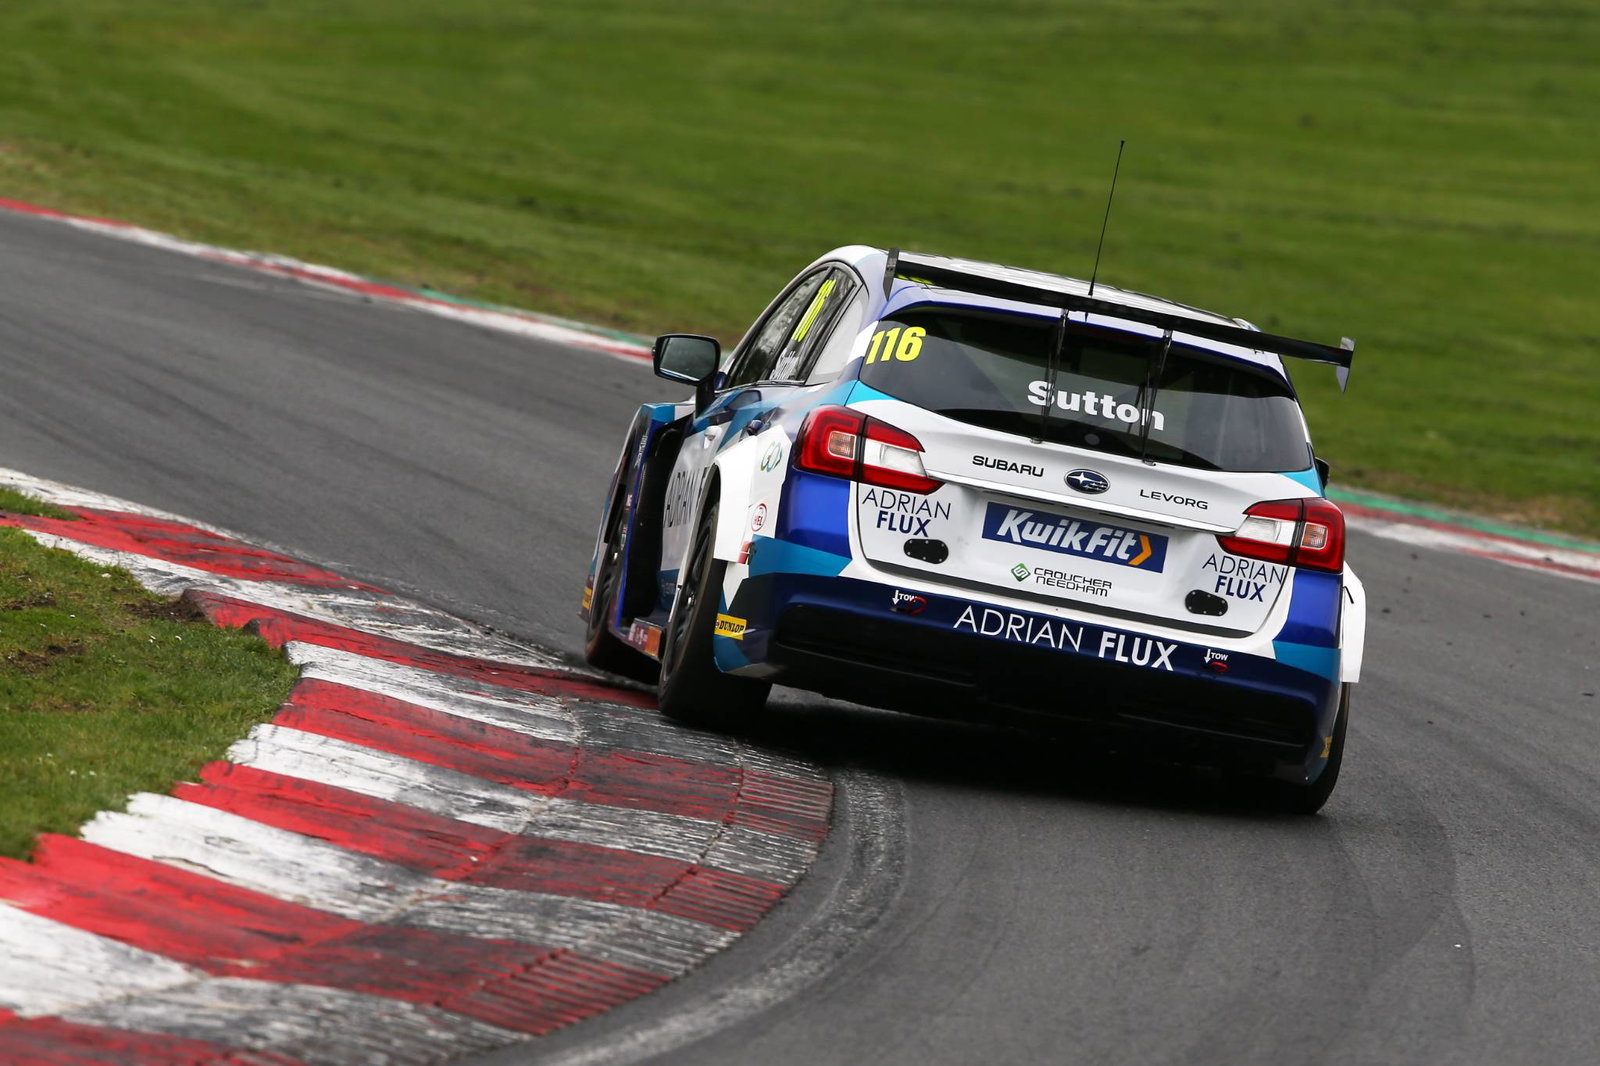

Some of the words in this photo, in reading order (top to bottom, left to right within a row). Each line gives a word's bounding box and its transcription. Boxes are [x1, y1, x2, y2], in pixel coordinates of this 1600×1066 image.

[866, 326, 926, 364] 116
[1027, 380, 1165, 431] Sutton
[972, 455, 1044, 477] SUBARU
[862, 488, 952, 521] ADRIAN
[1139, 488, 1209, 511] LEVORG
[875, 510, 931, 538] FLUX
[1033, 566, 1113, 591] CROUCHER
[1201, 552, 1286, 586] ADRIAN
[1035, 577, 1109, 599] NEEDHAM
[1214, 574, 1267, 603] FLUX
[719, 619, 745, 634] DUNLOP
[953, 605, 1084, 653] ADRIAN
[1098, 631, 1179, 672] FLUX
[1210, 652, 1229, 661] TOW
